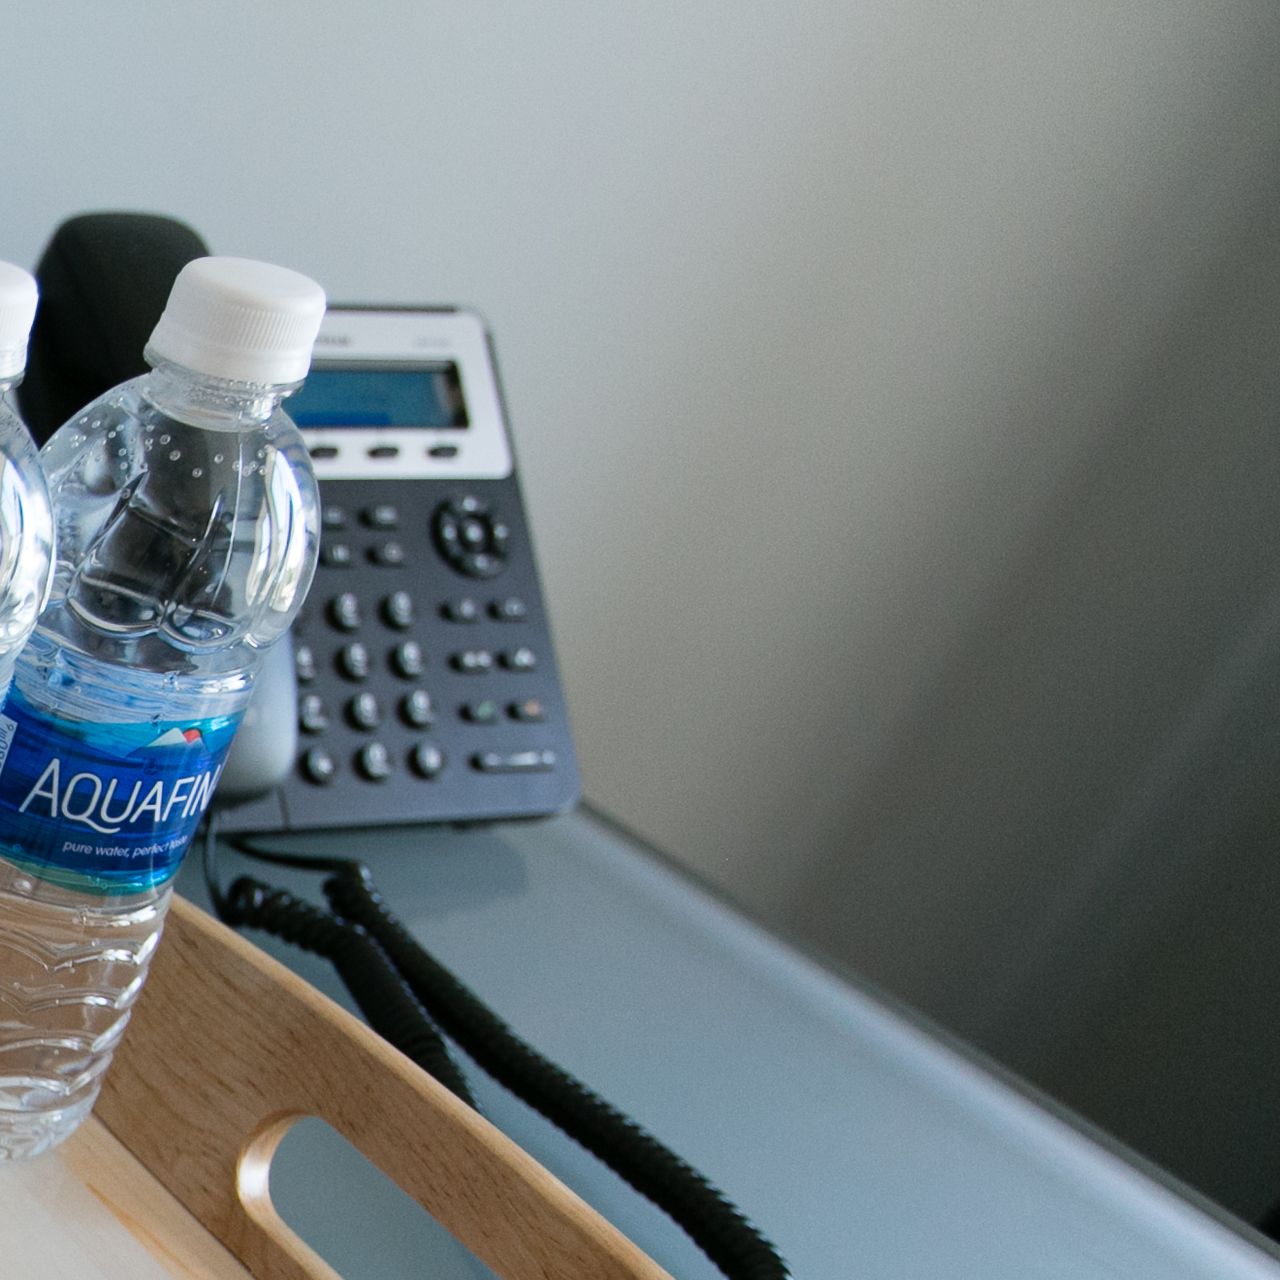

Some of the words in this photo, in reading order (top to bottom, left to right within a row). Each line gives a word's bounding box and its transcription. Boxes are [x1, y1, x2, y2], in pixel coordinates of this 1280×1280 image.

[62, 841, 92, 854] pure
[95, 843, 130, 858] water,
[132, 841, 169, 859] perfect
